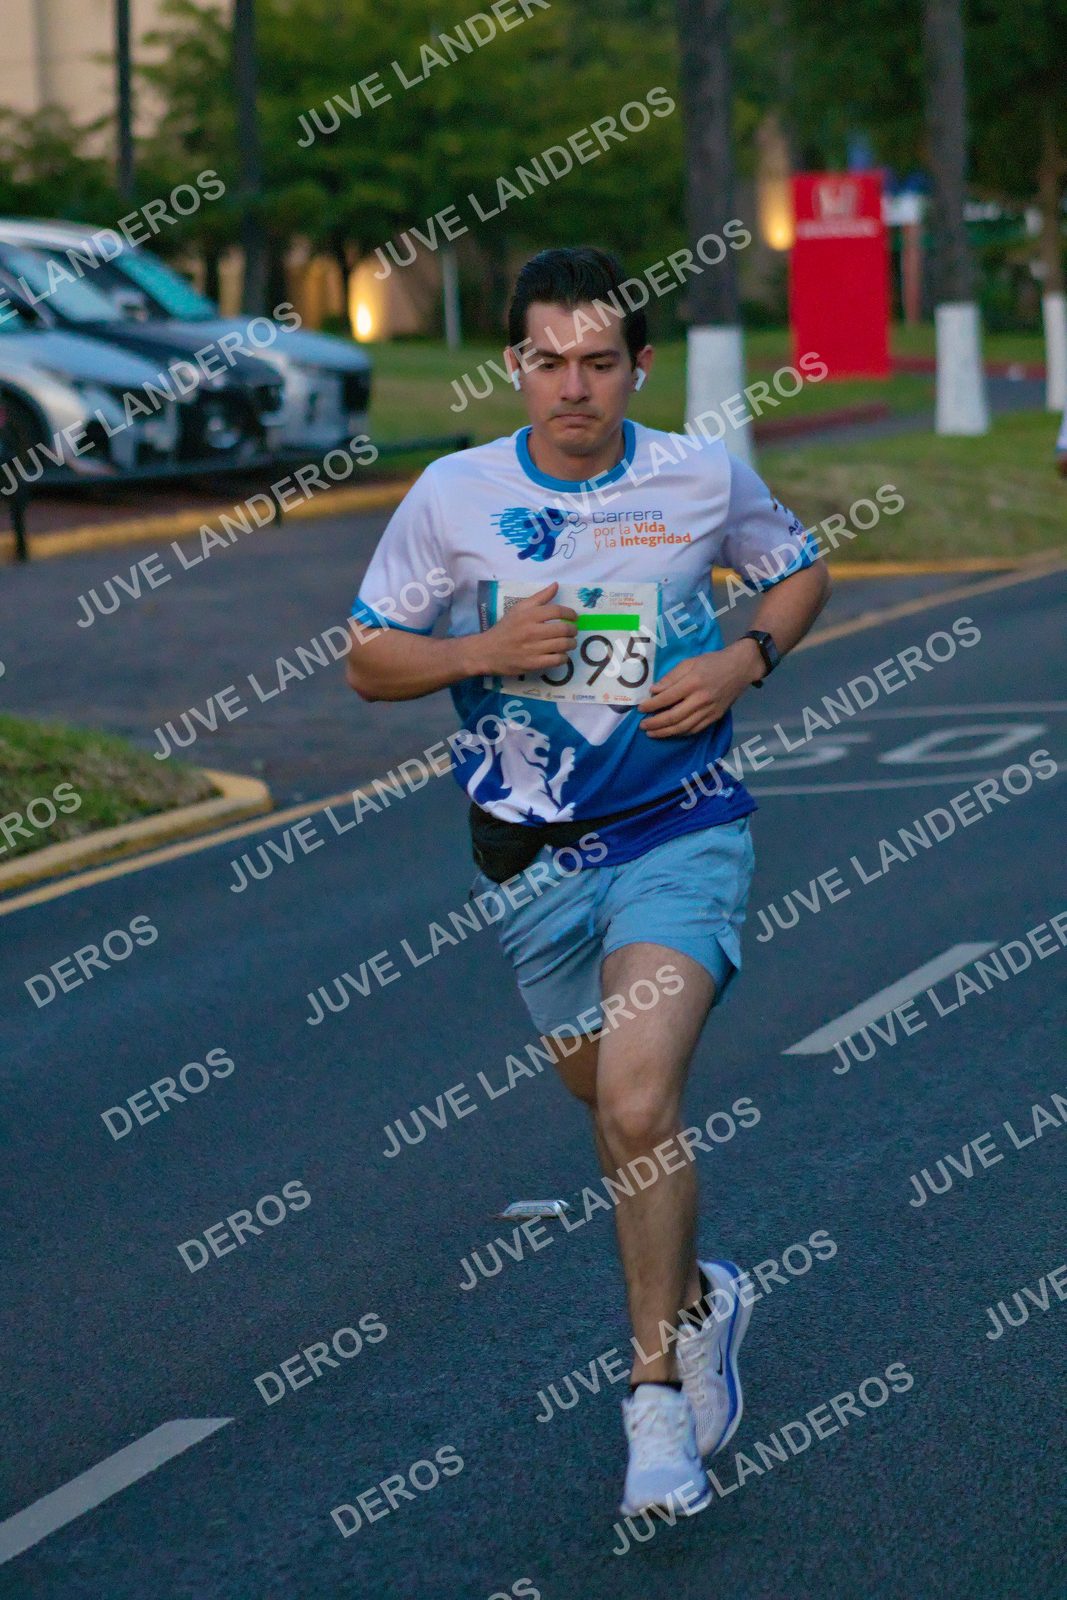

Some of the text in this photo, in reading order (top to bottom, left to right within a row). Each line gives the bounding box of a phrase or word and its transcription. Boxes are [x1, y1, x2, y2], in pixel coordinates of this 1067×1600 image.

[592, 510, 663, 524] Carrera
[593, 521, 667, 539] por la Vida
[604, 534, 617, 548] la
[620, 532, 692, 548] Integridad
